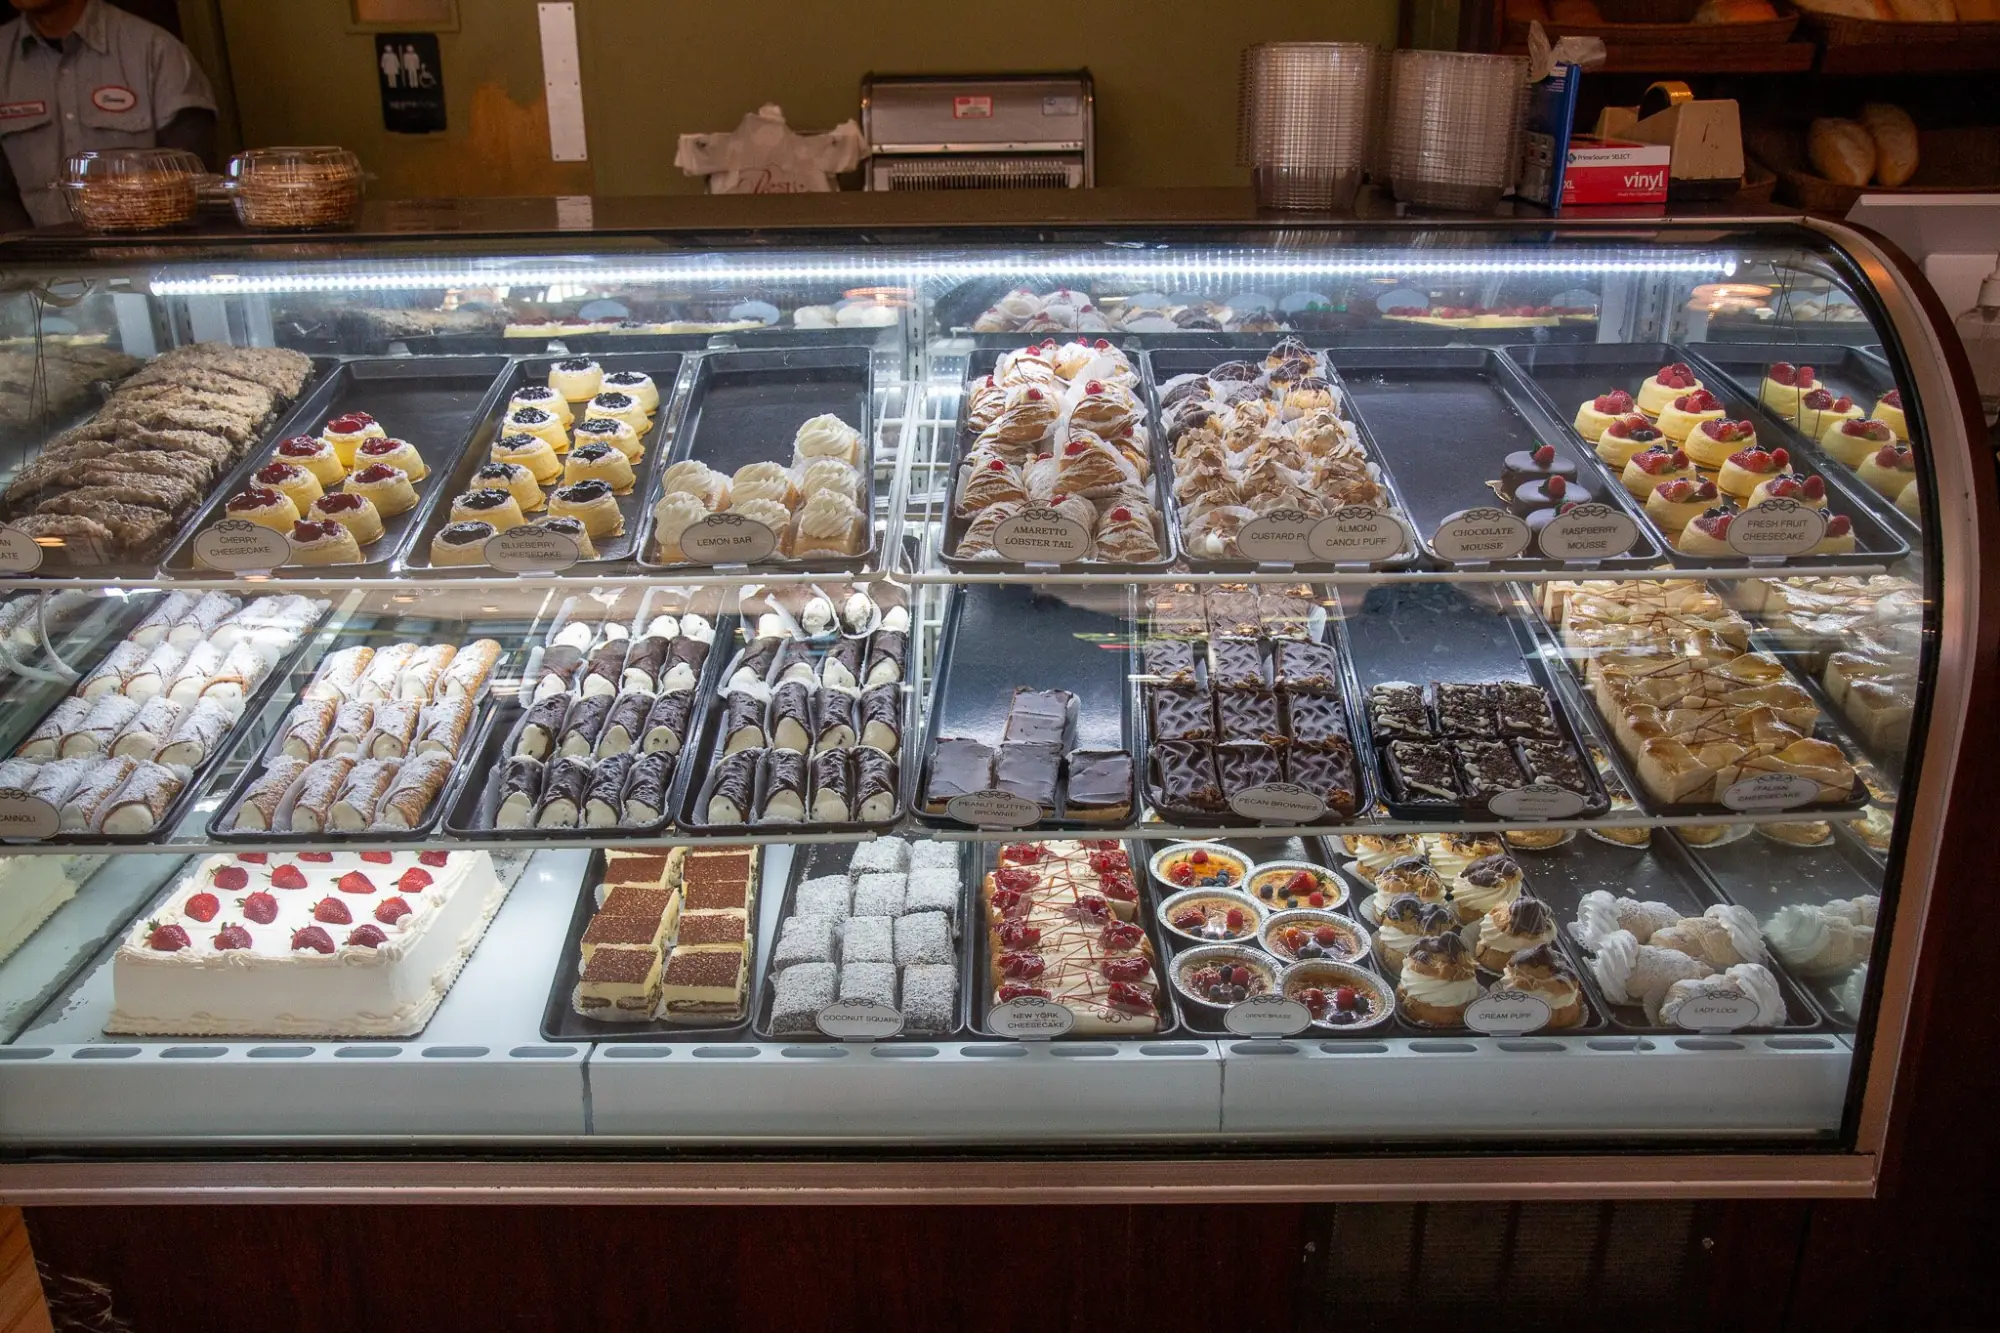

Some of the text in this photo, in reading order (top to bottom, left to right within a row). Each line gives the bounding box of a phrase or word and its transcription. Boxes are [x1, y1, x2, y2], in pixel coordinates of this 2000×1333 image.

[1563, 180, 1575, 189] XL
[1623, 170, 1664, 191] vinyl
[1747, 519, 1808, 528] FRESH FRUIT
[1013, 526, 1067, 536] AMARETTO
[1337, 524, 1377, 533] ALMOND
[1452, 527, 1514, 537] CHOCOLATE
[1561, 526, 1618, 535] RASPBERRY
[219, 536, 257, 544] CHERRY
[1251, 532, 1294, 541] CUSTARD
[1742, 532, 1805, 541] CHEESECAKE
[501, 541, 557, 549] BLUEBERRY
[696, 536, 752, 547] LEMON BAR
[1004, 537, 1074, 549] LOBSTER TAIL
[1326, 537, 1388, 547] CANOLI PUFF
[1567, 540, 1608, 550] MOUSSE
[210, 546, 271, 556] CHEESECAKE
[1460, 542, 1503, 551] MOUSSE
[499, 551, 562, 559] CHEESECAKE
[996, 803, 1032, 811] BUTTER
[1238, 797, 1318, 811] PECAN BROWNIES
[865, 1015, 900, 1024] SQUARE
[1008, 1021, 1064, 1029] CHEESECAKE
